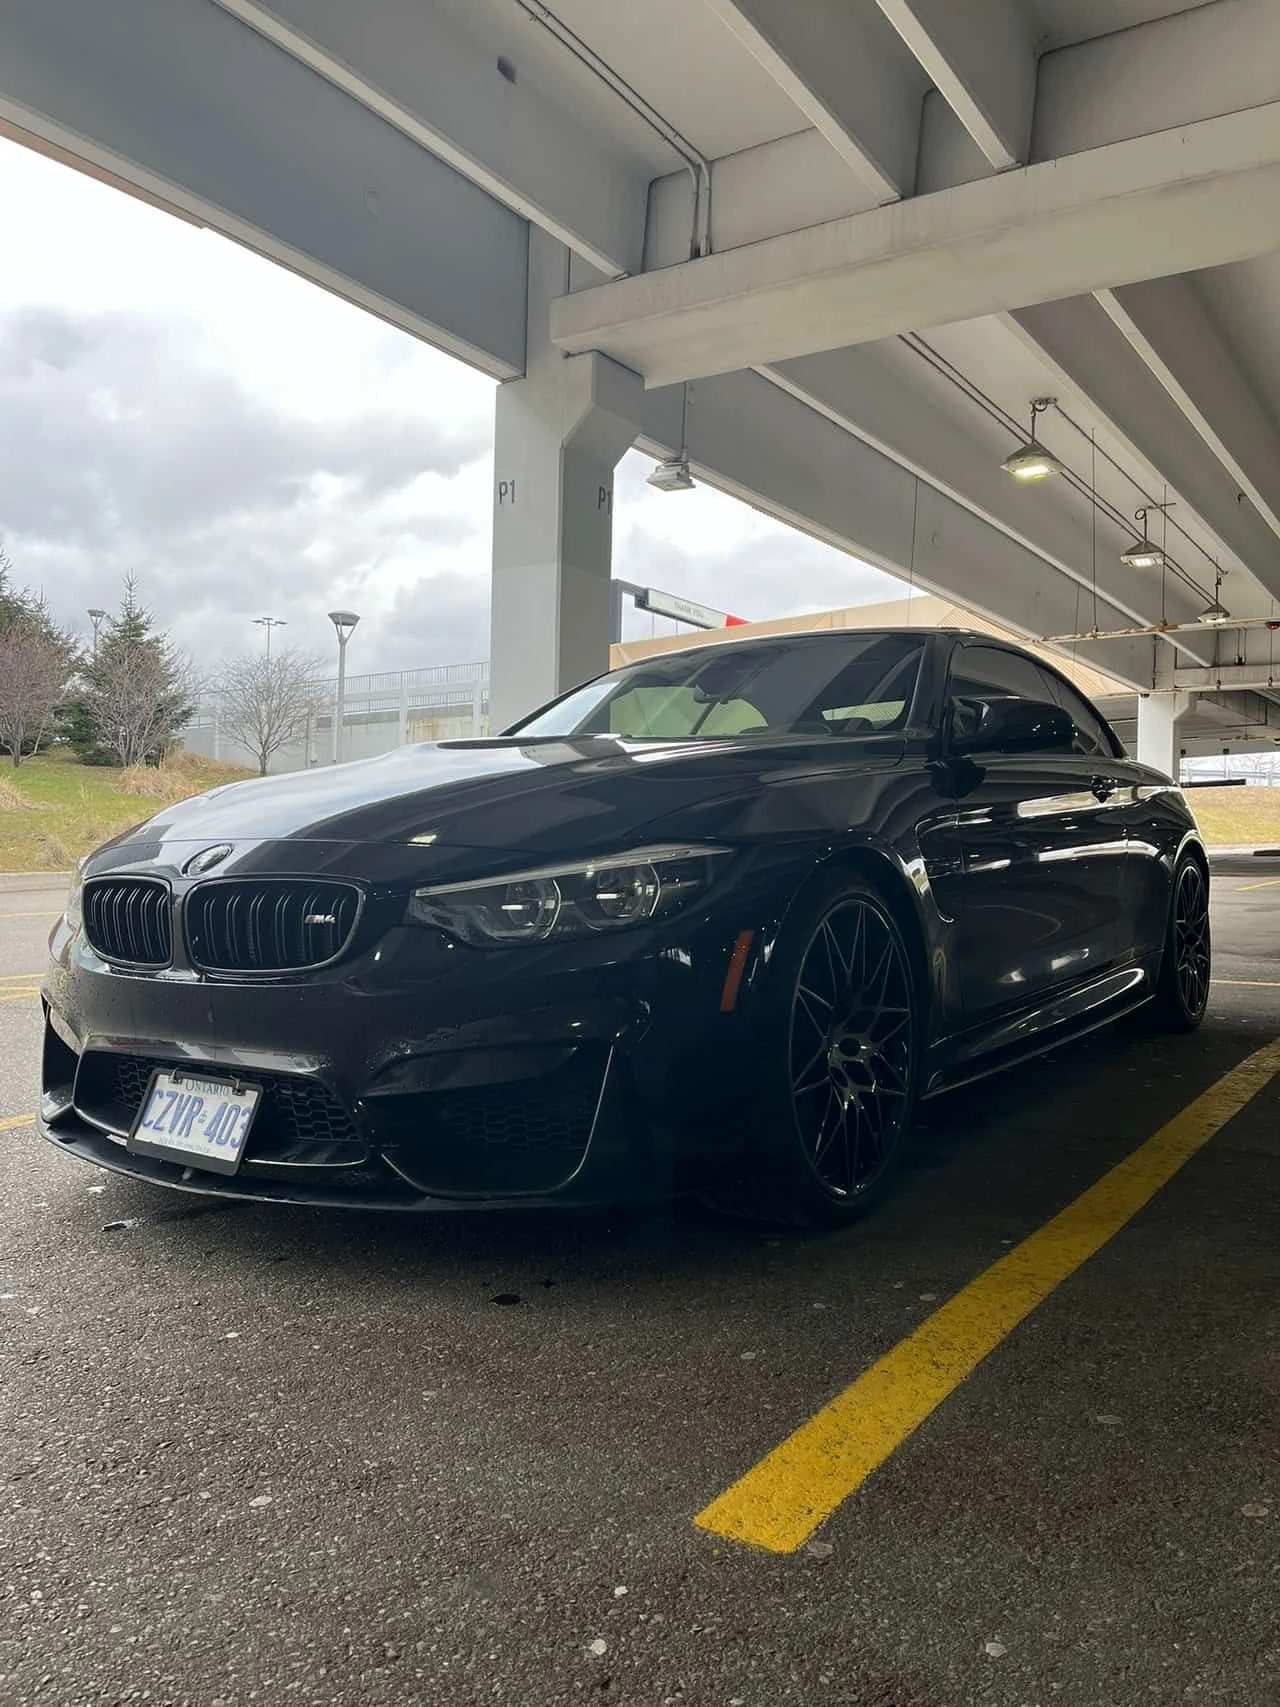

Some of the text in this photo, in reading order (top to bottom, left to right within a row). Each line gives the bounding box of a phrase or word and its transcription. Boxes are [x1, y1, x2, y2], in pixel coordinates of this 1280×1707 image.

[499, 479, 515, 505] P1
[185, 1078, 231, 1097] ONTARIO
[142, 1089, 252, 1149] CZVR 403
